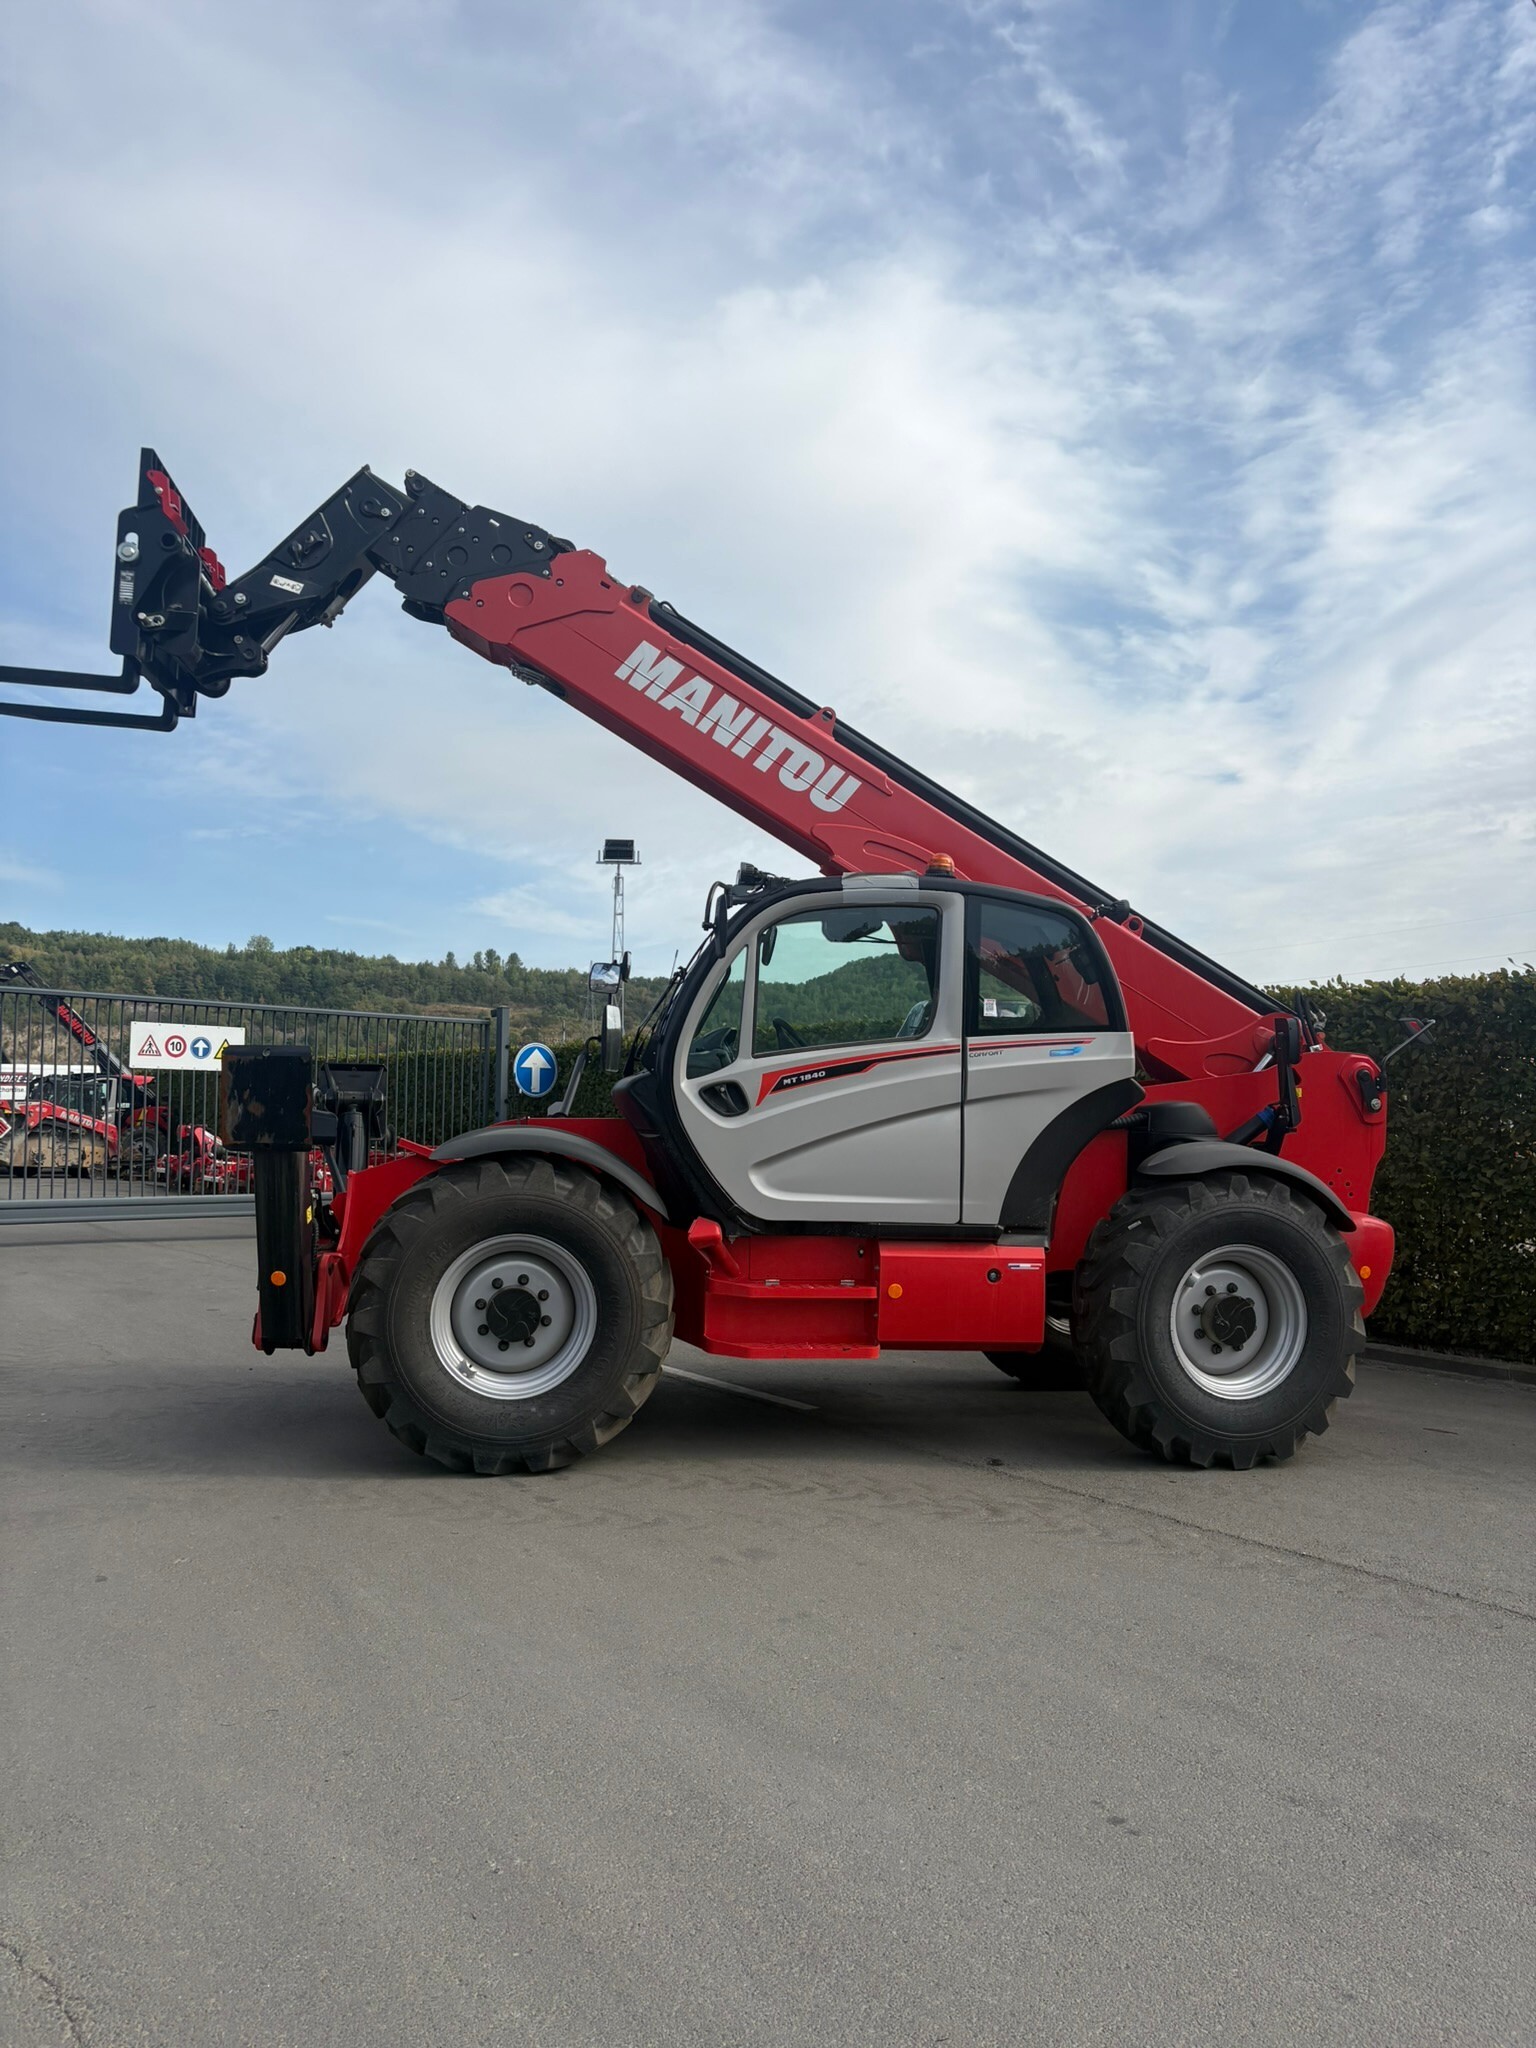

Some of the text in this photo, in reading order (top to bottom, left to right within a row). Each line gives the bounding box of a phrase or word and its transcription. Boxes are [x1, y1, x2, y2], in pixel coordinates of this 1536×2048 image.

[614, 640, 862, 813] MANITOU
[170, 1041, 182, 1051] 10
[783, 1070, 826, 1085] MT 1840
